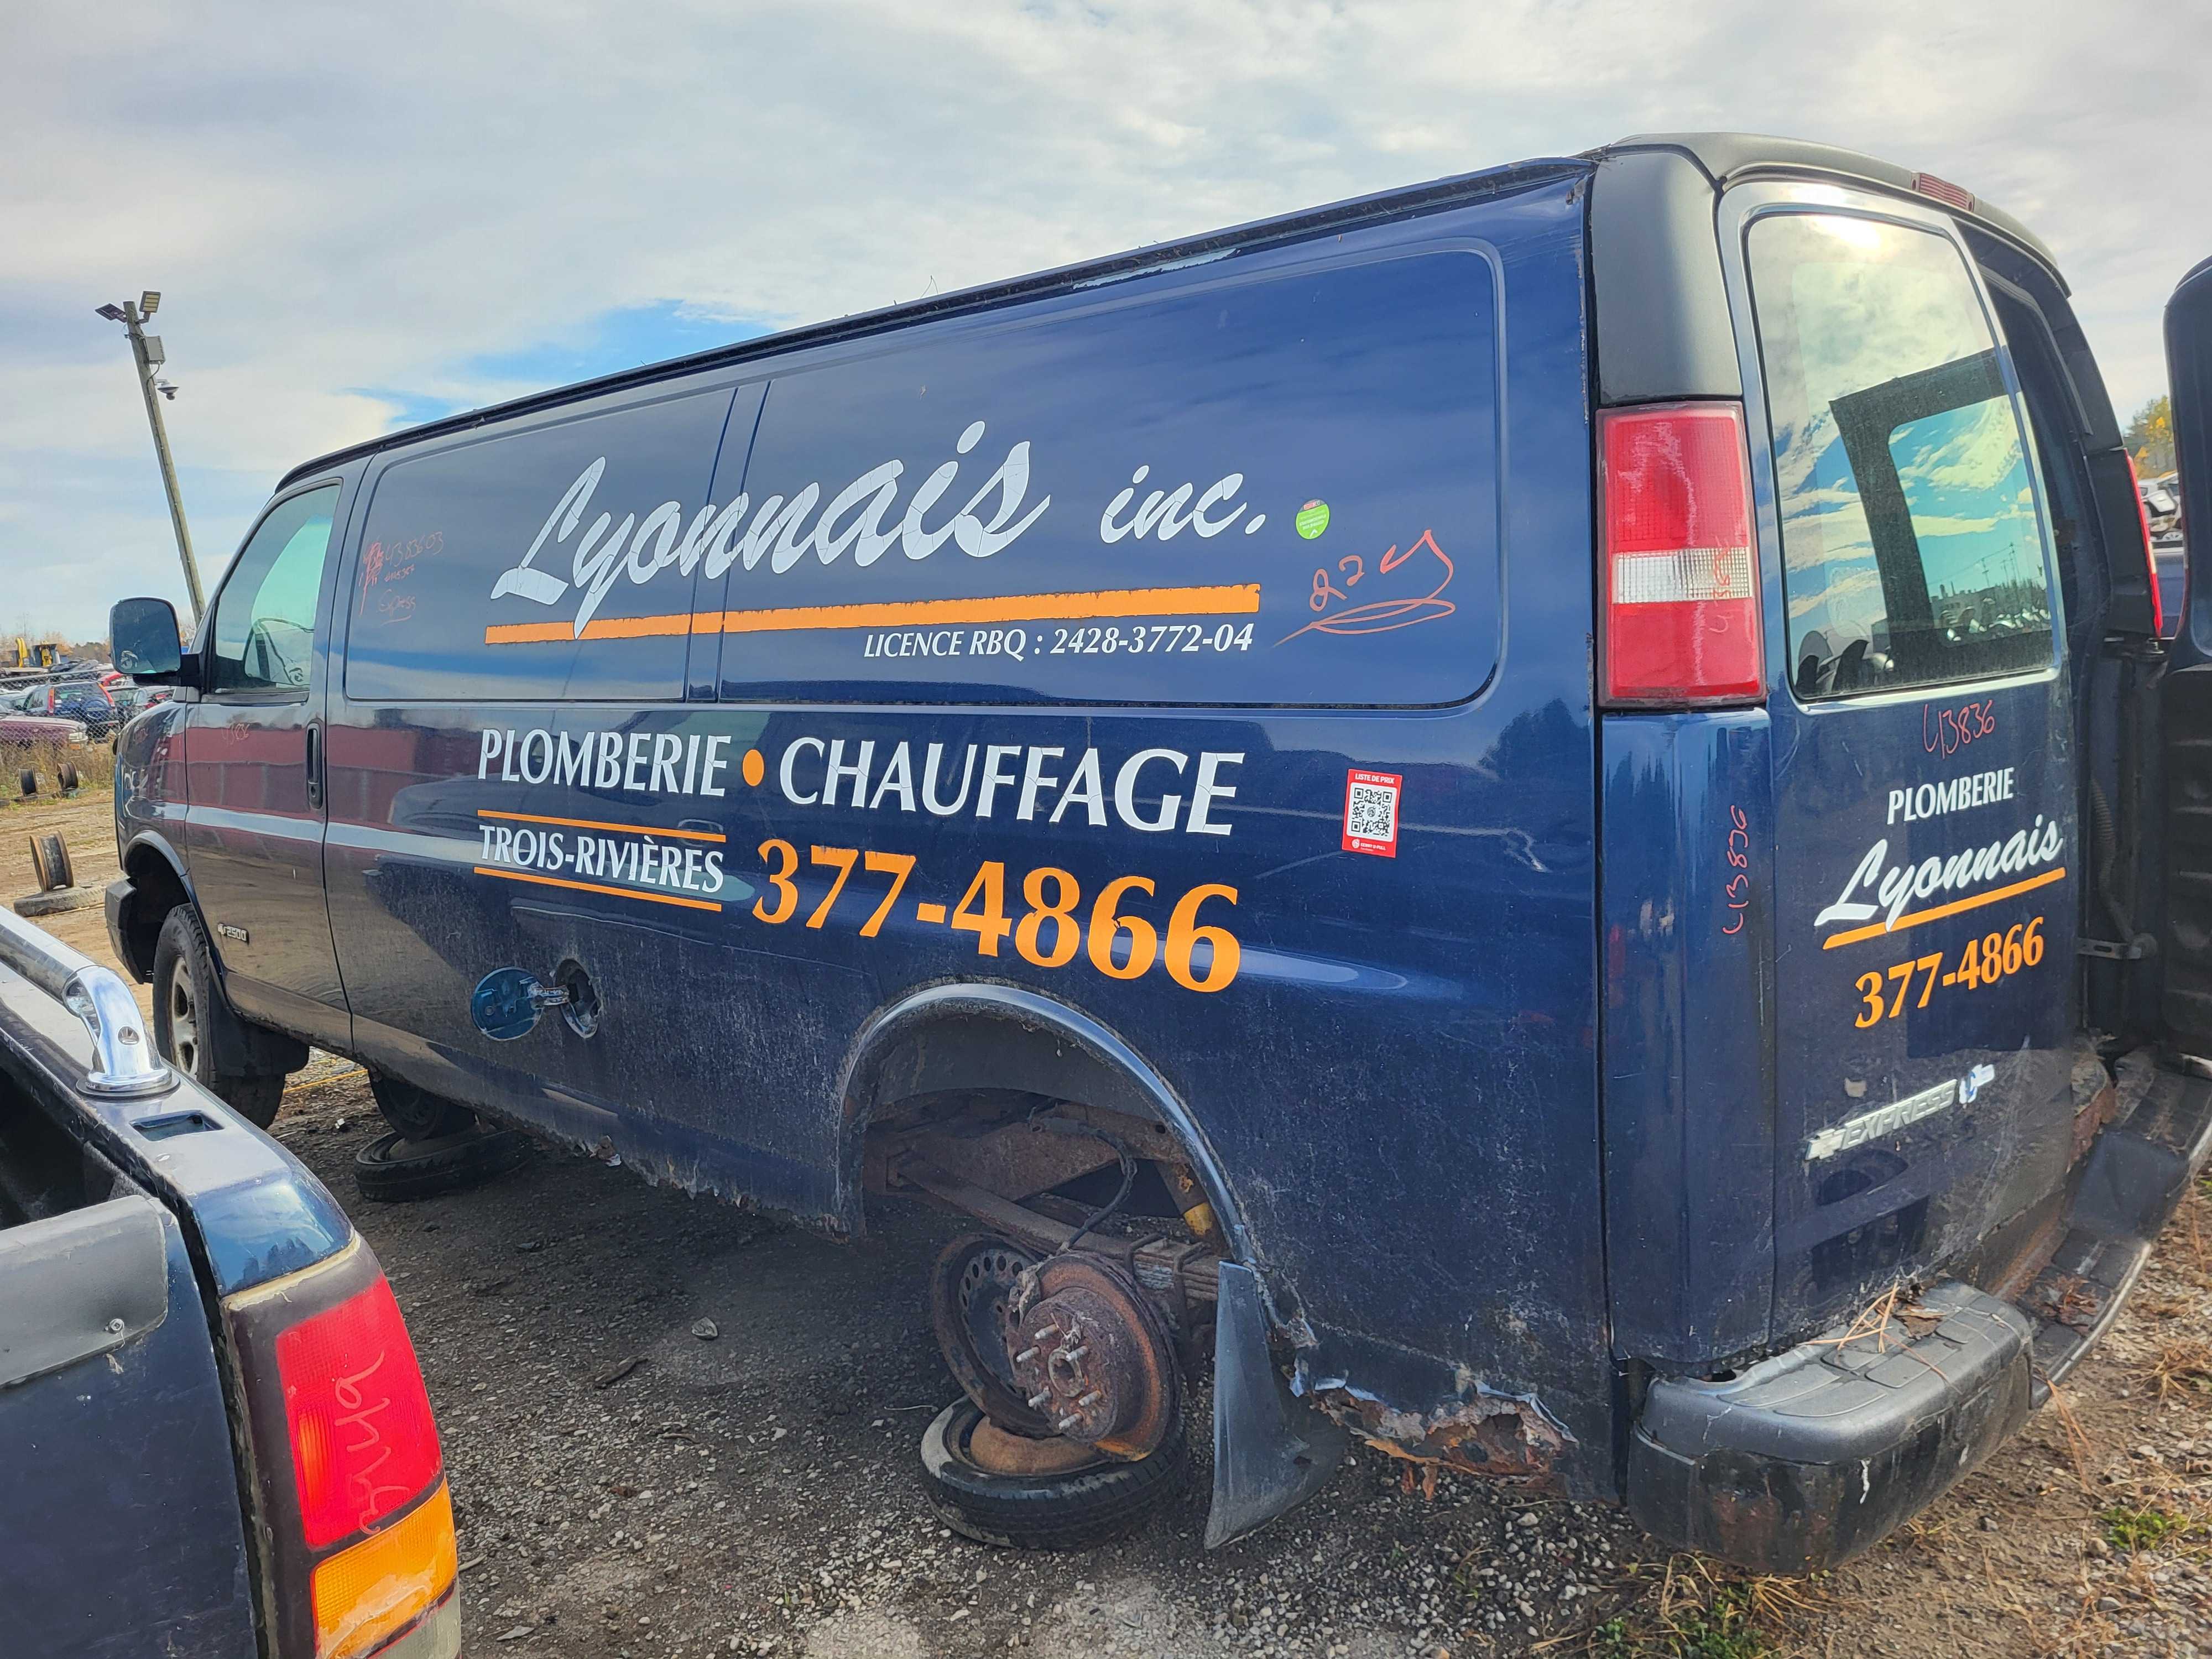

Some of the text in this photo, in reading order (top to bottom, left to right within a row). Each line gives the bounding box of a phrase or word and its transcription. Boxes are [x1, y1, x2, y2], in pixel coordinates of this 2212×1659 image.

[490, 420, 1266, 639] Lyonnais inc.
[864, 629, 965, 658] LICENCE
[968, 628, 1027, 662] RBQ
[1050, 623, 1254, 655] 2428-3772-04
[477, 728, 1246, 836] PLOMBERIE CHAUFFAGE
[1355, 773, 1371, 781] LISTE
[1380, 776, 1395, 784] PRIX
[1886, 767, 2015, 825] PLOMBERIE
[479, 824, 724, 893] TROIS-RIVIÈRES
[1813, 813, 2064, 932] Lyonnais
[752, 838, 1241, 993] 377-4866
[1854, 916, 2044, 1029] 377-4866
[1841, 1080, 1958, 1150] EXPRESS
